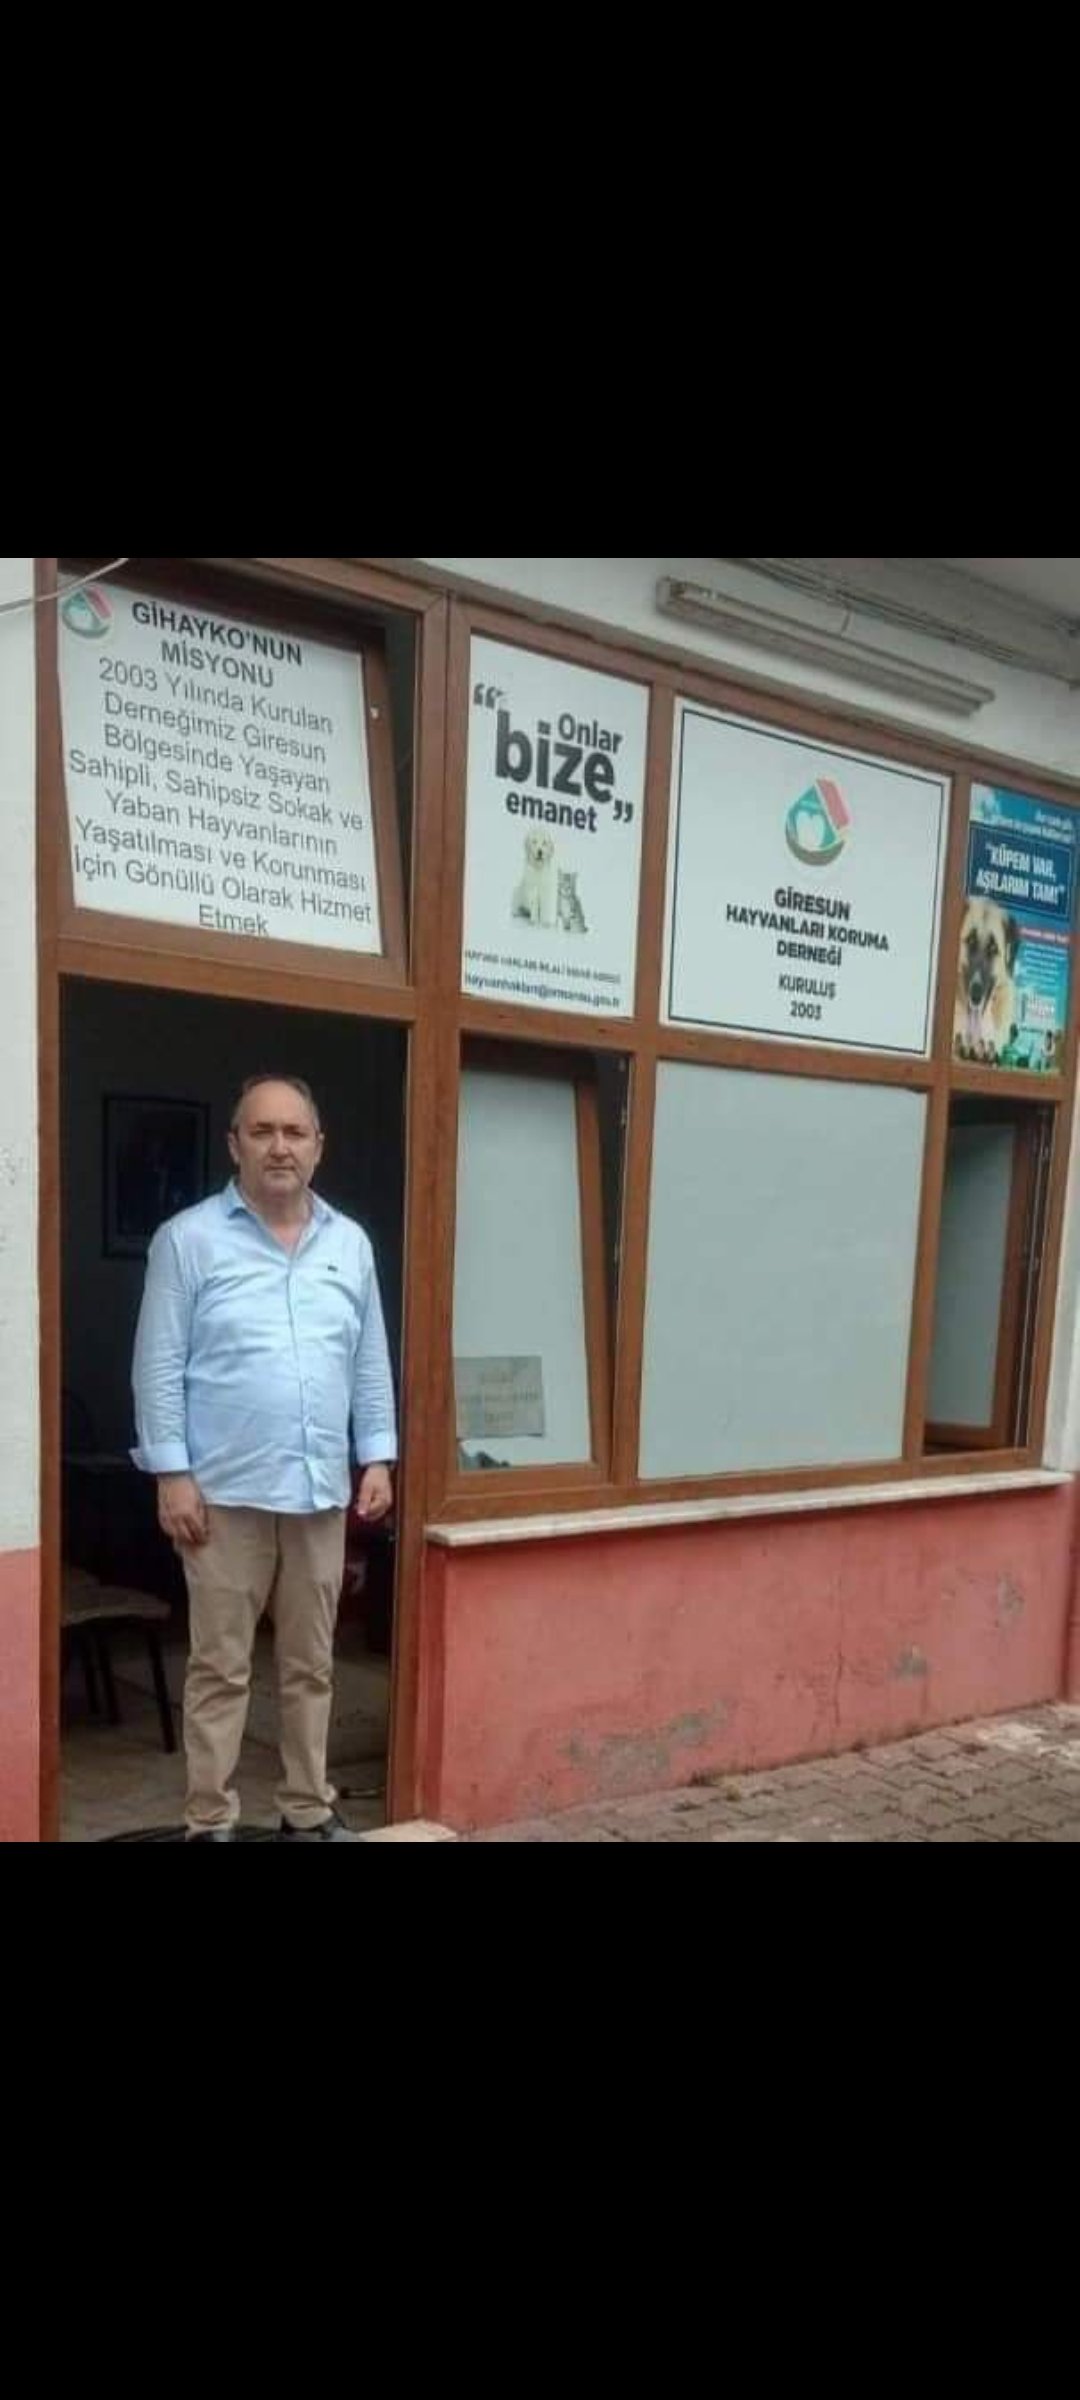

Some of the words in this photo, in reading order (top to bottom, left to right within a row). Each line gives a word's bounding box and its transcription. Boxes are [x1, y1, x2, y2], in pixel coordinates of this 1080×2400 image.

[132, 601, 301, 666] GİHAYKO'NUN
[161, 640, 274, 688] MİSYONU
[99, 658, 158, 692] 2003
[166, 674, 243, 712] Yılında
[252, 696, 333, 734] Kurulan
[104, 691, 235, 741] Derneğimiz
[243, 724, 326, 763] Giresun
[558, 712, 623, 754] Onlar
[104, 724, 233, 772] Bölgesinde
[238, 755, 330, 794] Yaşayan
[495, 708, 615, 804] bize
[70, 750, 158, 792] Sahipli,
[167, 770, 260, 809] Sahipsiz
[269, 792, 332, 824] Sokak
[339, 811, 363, 831] ve
[505, 791, 598, 833] emanet
[106, 789, 180, 825] Yaban
[189, 806, 337, 854] Hayvanlarının
[76, 816, 212, 863] Yaşatılması
[220, 848, 246, 870] ve
[254, 851, 367, 892] Korunması
[75, 846, 117, 881] İçin
[126, 860, 215, 896] Gönüllü
[222, 877, 293, 910] Olarak
[301, 892, 371, 924] Hizmet
[774, 886, 851, 921] GİRESUN
[200, 904, 269, 937] Etmek
[726, 903, 825, 939] HAYVANLARI
[828, 925, 889, 952] KORUMA
[776, 939, 842, 967] DERNEĞİ
[778, 973, 836, 1000] KURULUŞ
[790, 1001, 822, 1021] 2003
